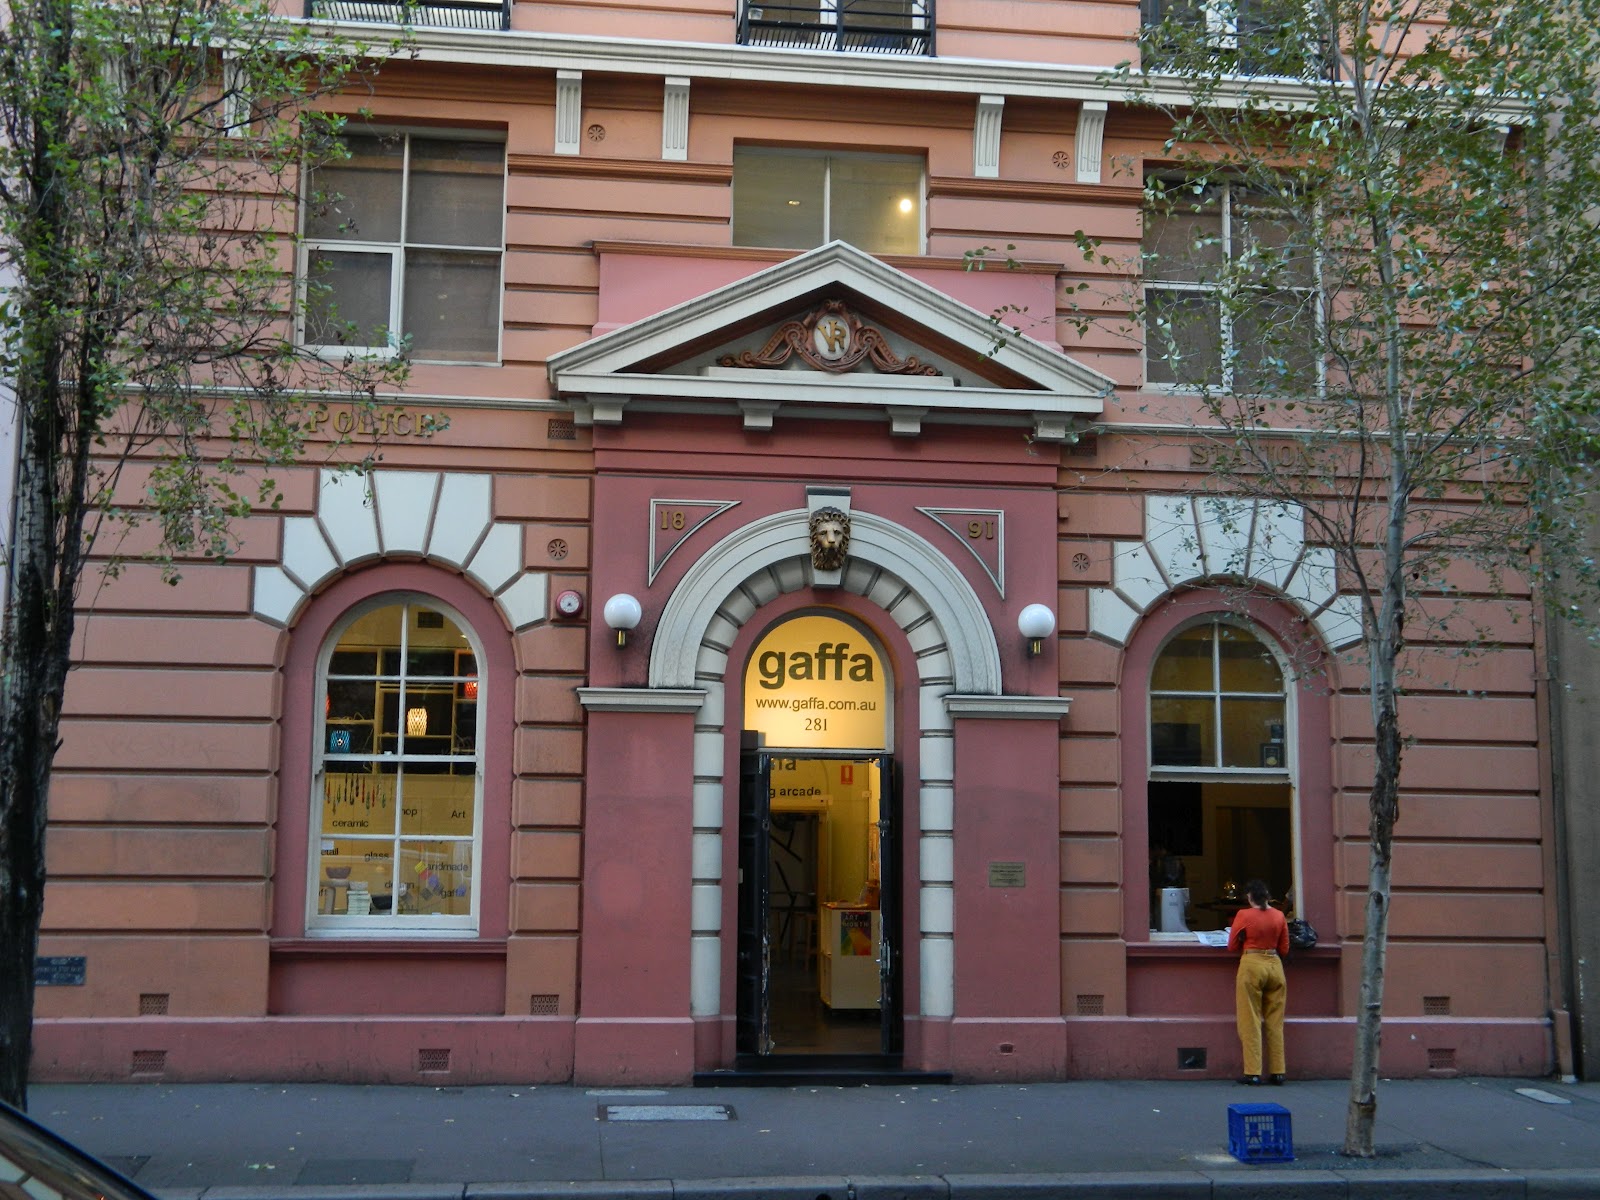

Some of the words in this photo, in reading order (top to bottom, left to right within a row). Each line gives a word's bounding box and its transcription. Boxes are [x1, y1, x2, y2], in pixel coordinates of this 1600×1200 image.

[660, 511, 685, 531] 18
[968, 520, 994, 540] 91
[758, 642, 875, 690] gaffa
[755, 697, 877, 712] www.gaffa.com.au
[805, 718, 828, 732] 281
[779, 787, 822, 797] arcade
[451, 810, 466, 819] Art
[332, 820, 369, 828] ceramic
[320, 847, 339, 856] etail
[364, 851, 390, 862] glass
[427, 862, 469, 872] andmade
